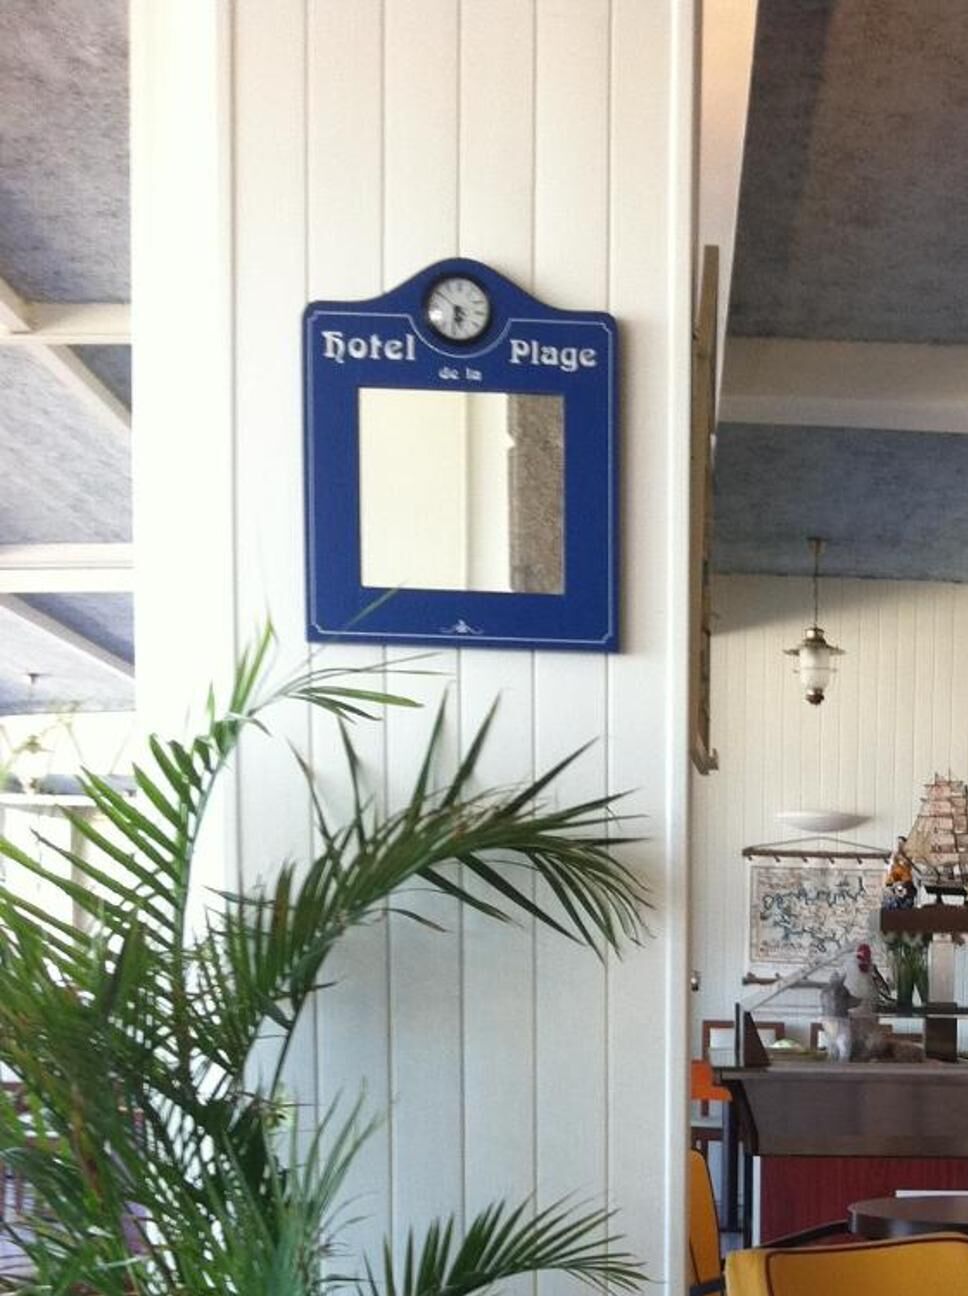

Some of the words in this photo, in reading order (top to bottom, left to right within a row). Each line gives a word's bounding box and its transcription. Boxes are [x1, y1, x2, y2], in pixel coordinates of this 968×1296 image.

[509, 339, 598, 372] Plage
[438, 366, 459, 380] de
[465, 367, 483, 381] la
